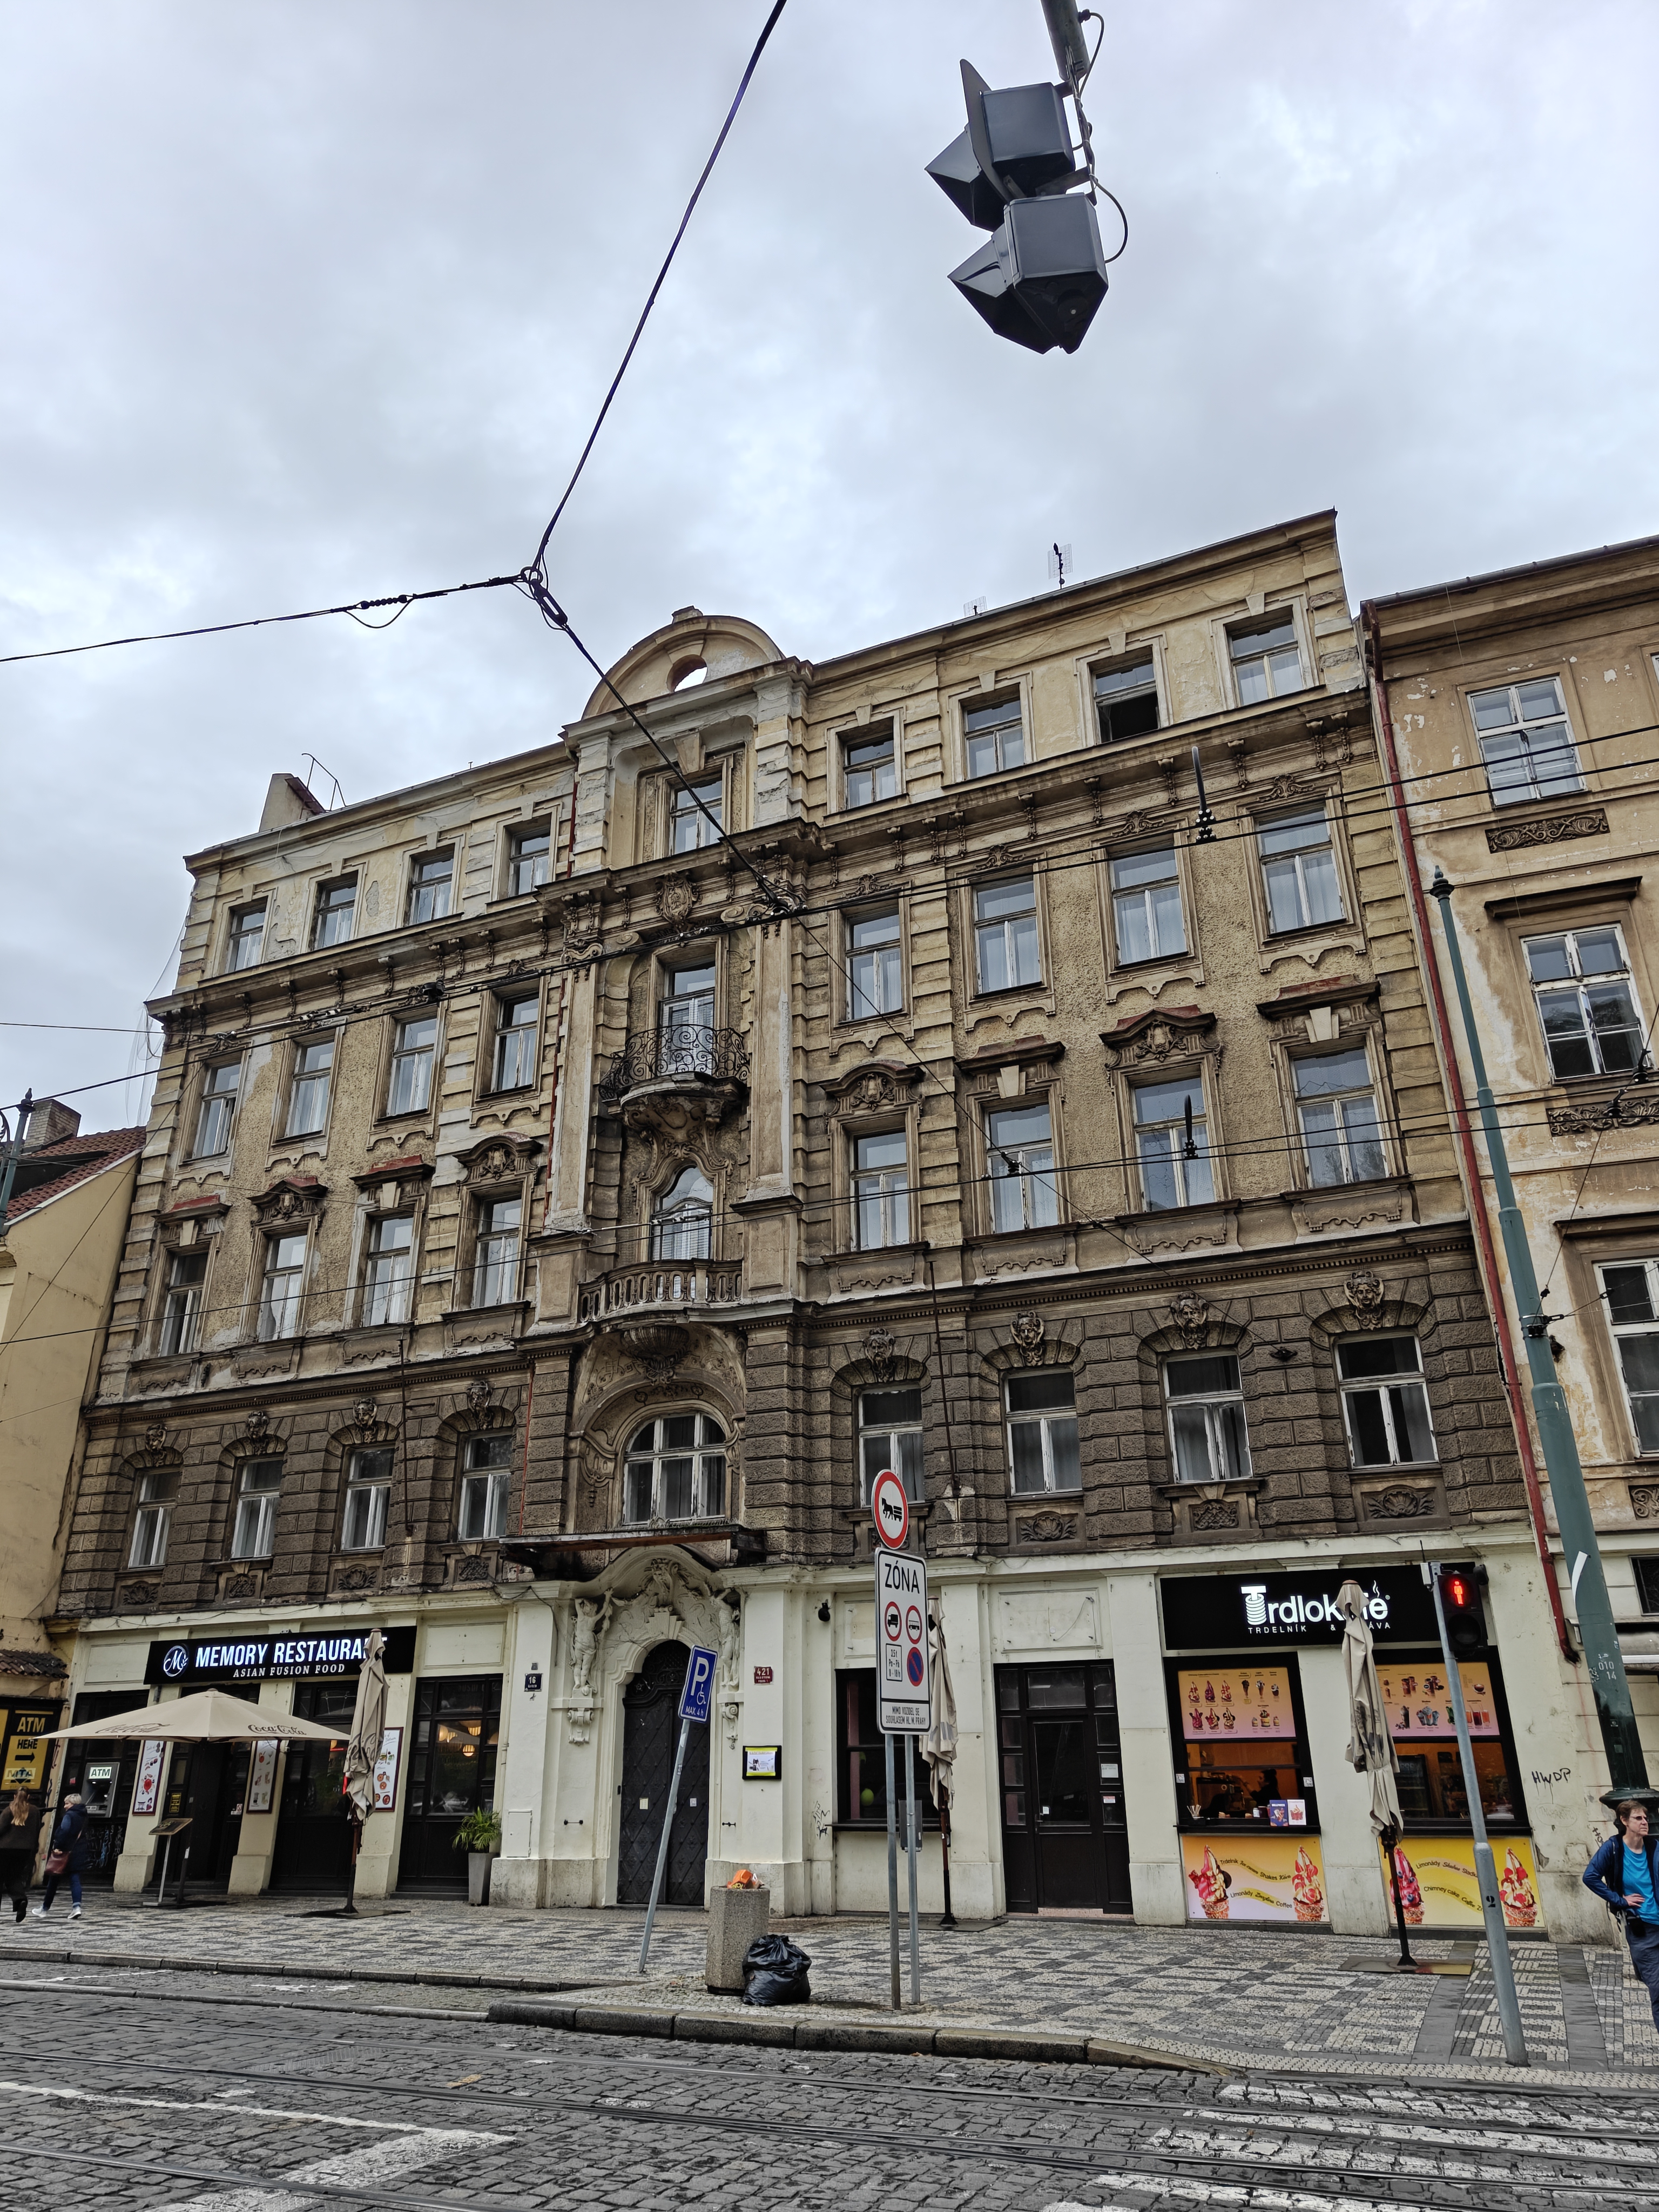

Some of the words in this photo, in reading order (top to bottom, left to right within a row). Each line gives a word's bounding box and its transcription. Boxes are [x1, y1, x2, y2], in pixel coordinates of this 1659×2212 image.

[885, 1560, 920, 1594] ZÓNA
[1240, 1585, 1388, 1626] Trdloke
[1247, 1623, 1307, 1634] TRDELNÍK
[1368, 1621, 1391, 1630] ÁVA
[195, 1643, 268, 1668] MEMORY
[1598, 1661, 1615, 1670] 010
[233, 1667, 266, 1678] ASIAN
[269, 1665, 310, 1676] FUSION
[315, 1663, 345, 1674] FOOD
[757, 1667, 770, 1676] 421
[529, 1676, 536, 1684] 16
[690, 1656, 709, 1696] P
[1606, 1671, 1617, 1680] 14
[697, 1708, 700, 1716] 4
[700, 1708, 704, 1717] h
[17, 1716, 46, 1732] ATM
[17, 1739, 38, 1749] HERE
[90, 1768, 111, 1777] ATM
[1532, 1768, 1571, 1783] HWDP
[1416, 1860, 1441, 1869] Limonády
[1259, 1872, 1278, 1880] Shakes
[1230, 1890, 1253, 1898] Limonády
[1447, 1889, 1460, 1898] cake
[1486, 1895, 1496, 1908] 2
